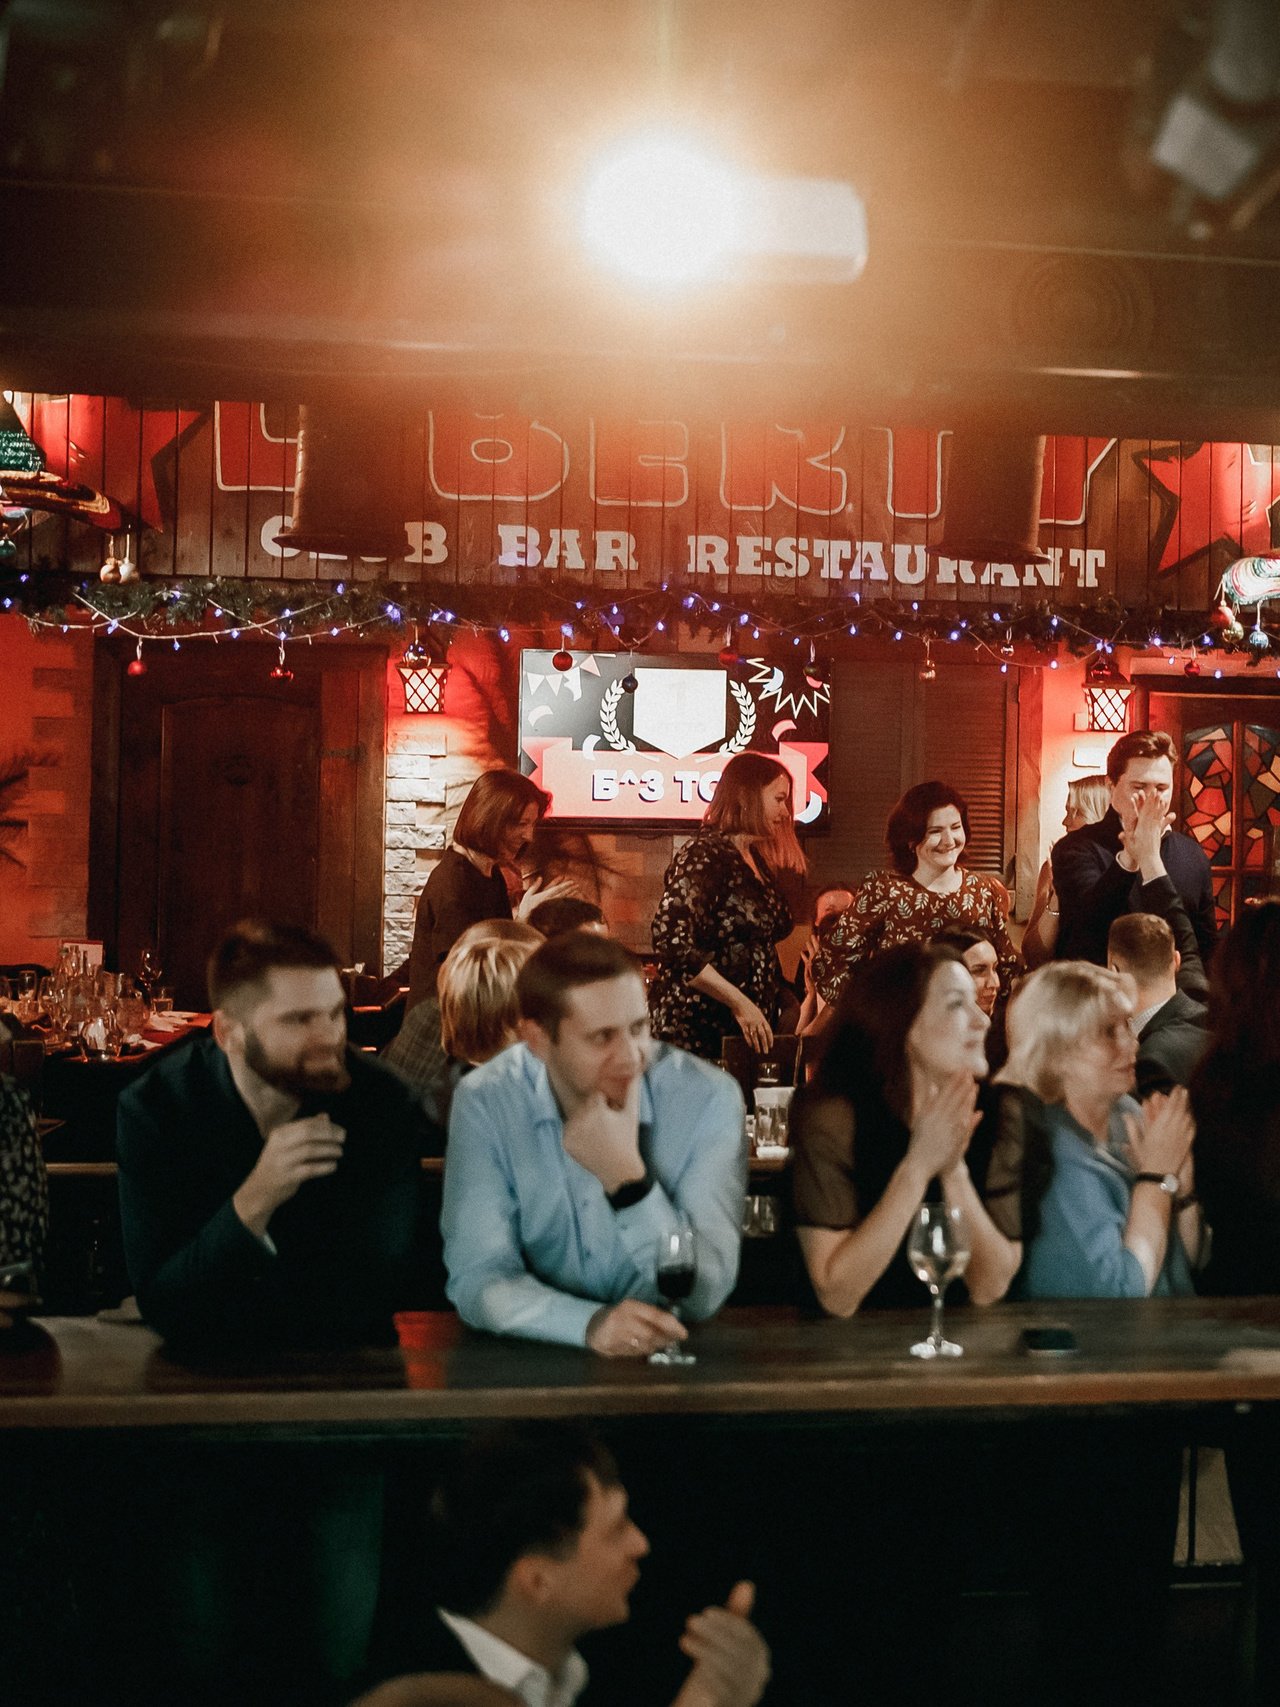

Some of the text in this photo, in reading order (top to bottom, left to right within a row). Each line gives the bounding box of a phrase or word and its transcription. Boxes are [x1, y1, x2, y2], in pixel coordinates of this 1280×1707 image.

[261, 515, 1106, 587] CB BAR RESTAURANT
